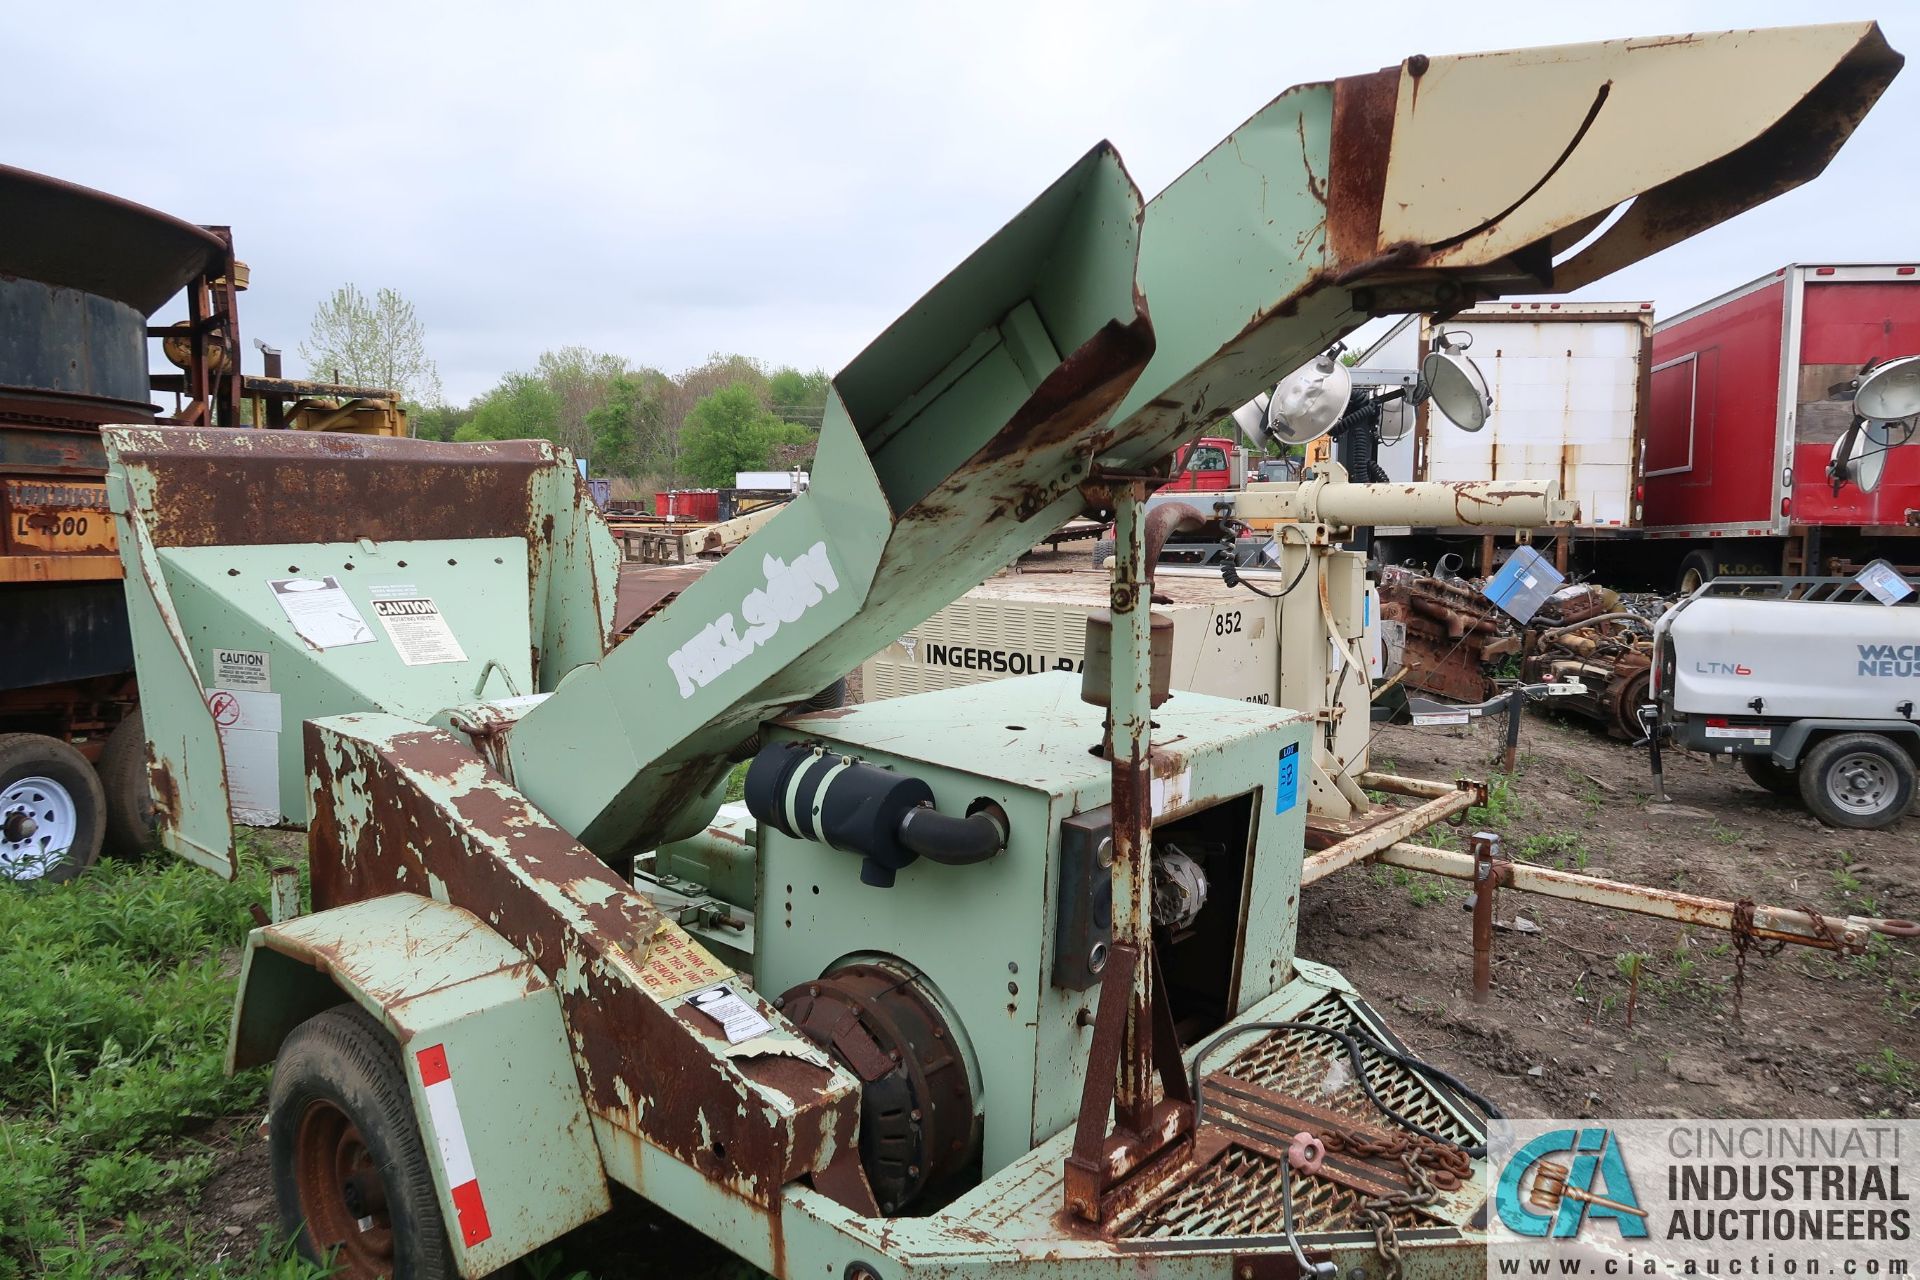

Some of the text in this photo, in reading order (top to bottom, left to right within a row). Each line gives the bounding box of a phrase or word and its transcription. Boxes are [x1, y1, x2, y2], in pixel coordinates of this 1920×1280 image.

[375, 600, 437, 615] CAUTION
[1215, 610, 1242, 637] 852
[219, 652, 264, 666] CAUTION
[1696, 662, 1752, 675] LTN6
[1283, 745, 1296, 757] LOT
[655, 945, 671, 956] ON
[667, 955, 687, 970] THIS
[682, 970, 705, 985] UNIT
[663, 933, 686, 950] EVEN
[682, 949, 707, 968] THINK
[702, 968, 718, 977] OF
[649, 960, 682, 985] REMOVE
